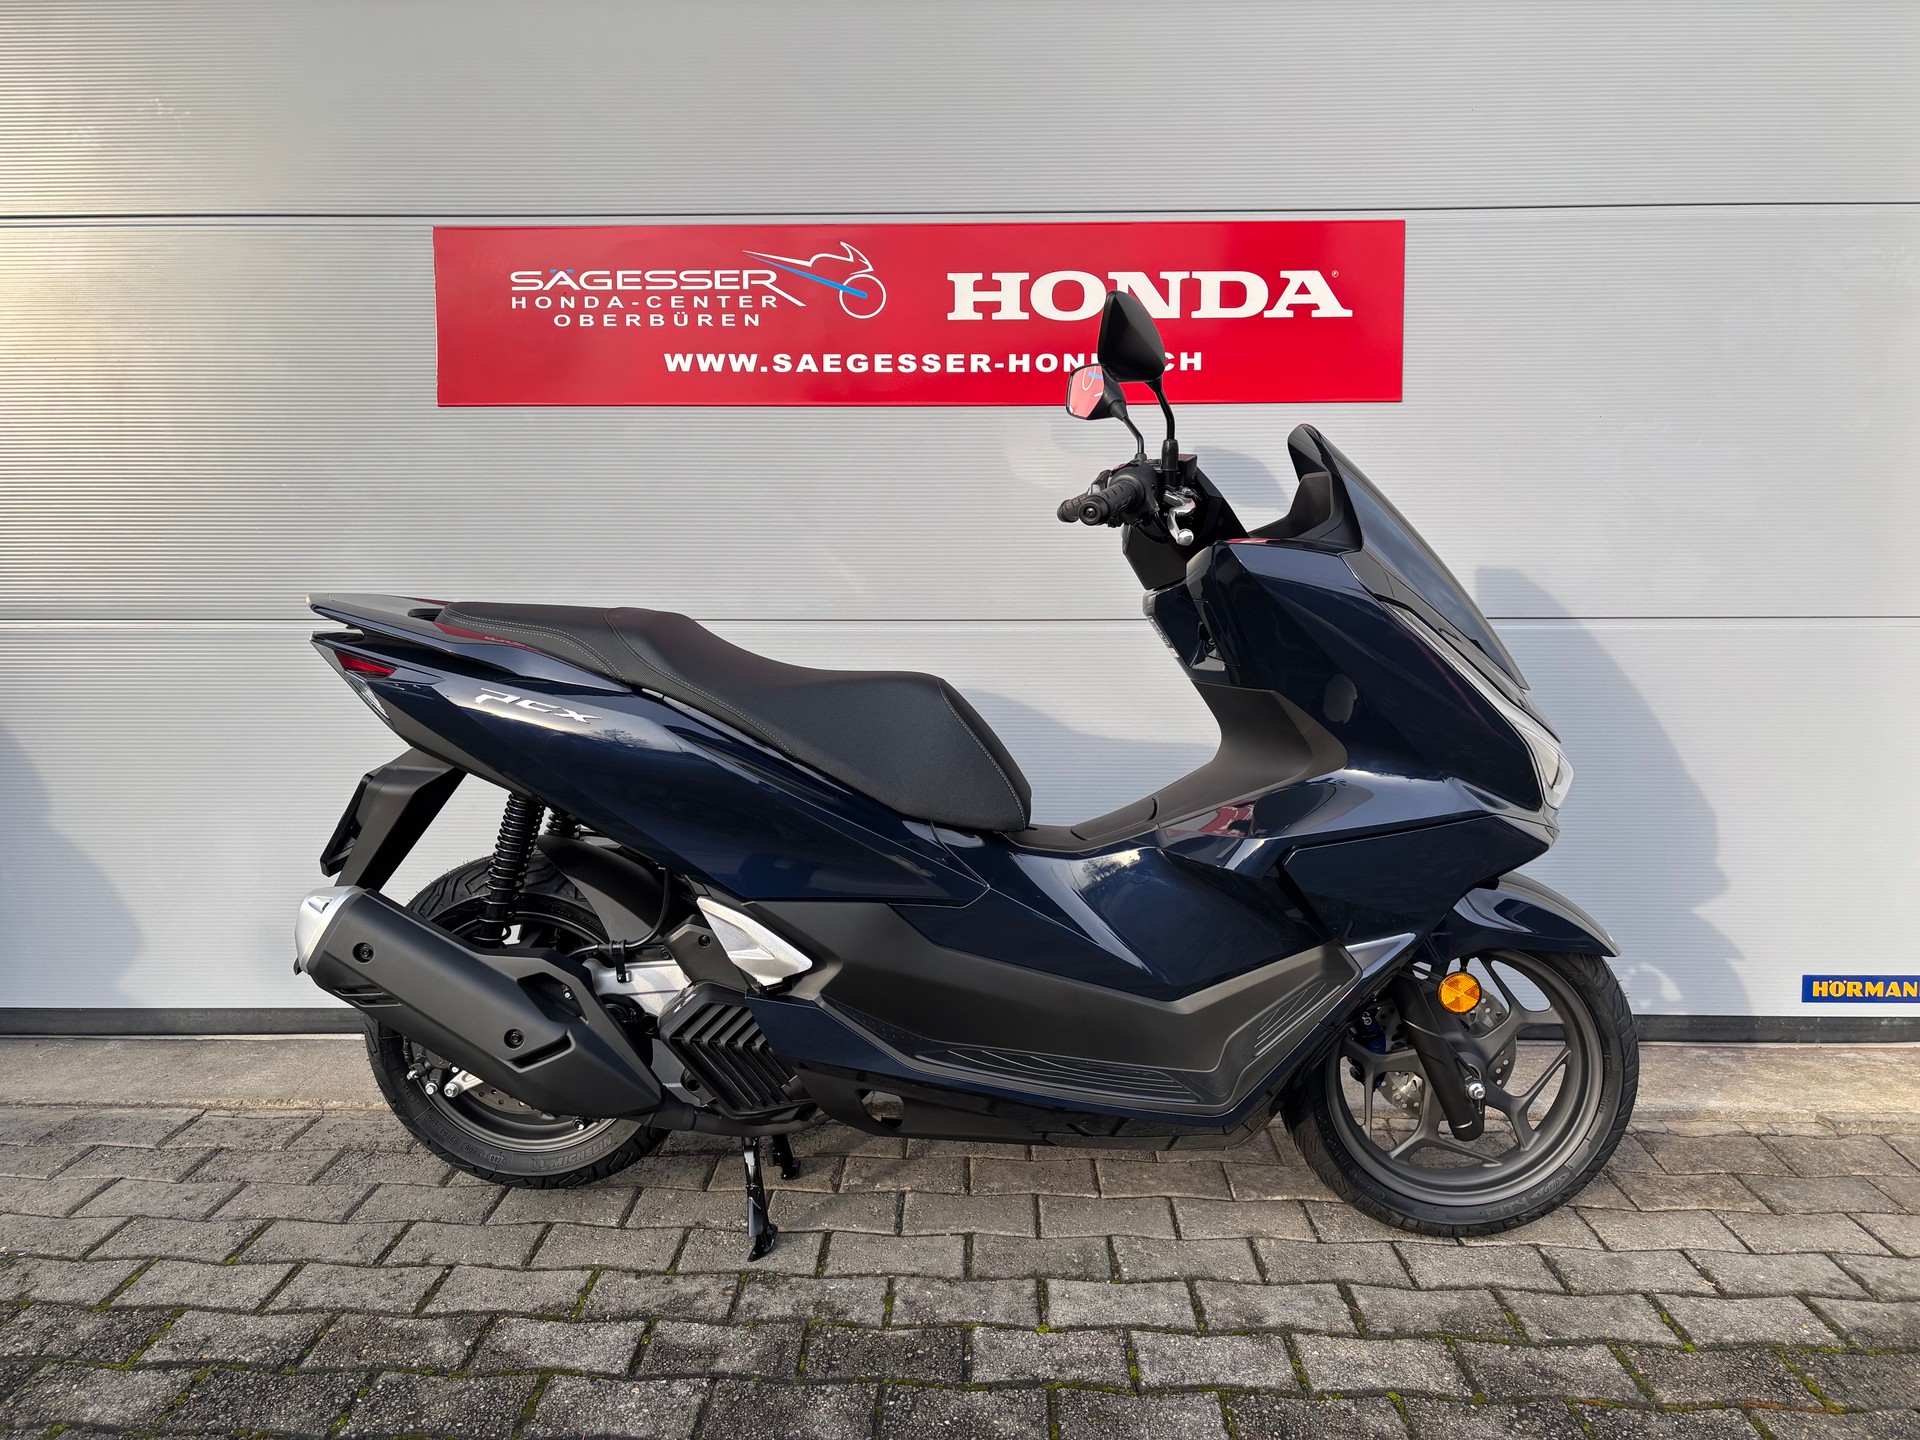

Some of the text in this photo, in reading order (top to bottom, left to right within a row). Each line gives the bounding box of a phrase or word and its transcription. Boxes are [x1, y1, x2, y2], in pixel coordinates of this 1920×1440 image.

[510, 268, 806, 306] SÄGESSER
[946, 270, 1353, 321] HONDA
[511, 295, 778, 309] HONDA-CENTER
[553, 312, 760, 327] OBERBÜREN
[474, 688, 602, 724] PCX
[1812, 980, 1920, 997] HÖRMAN
